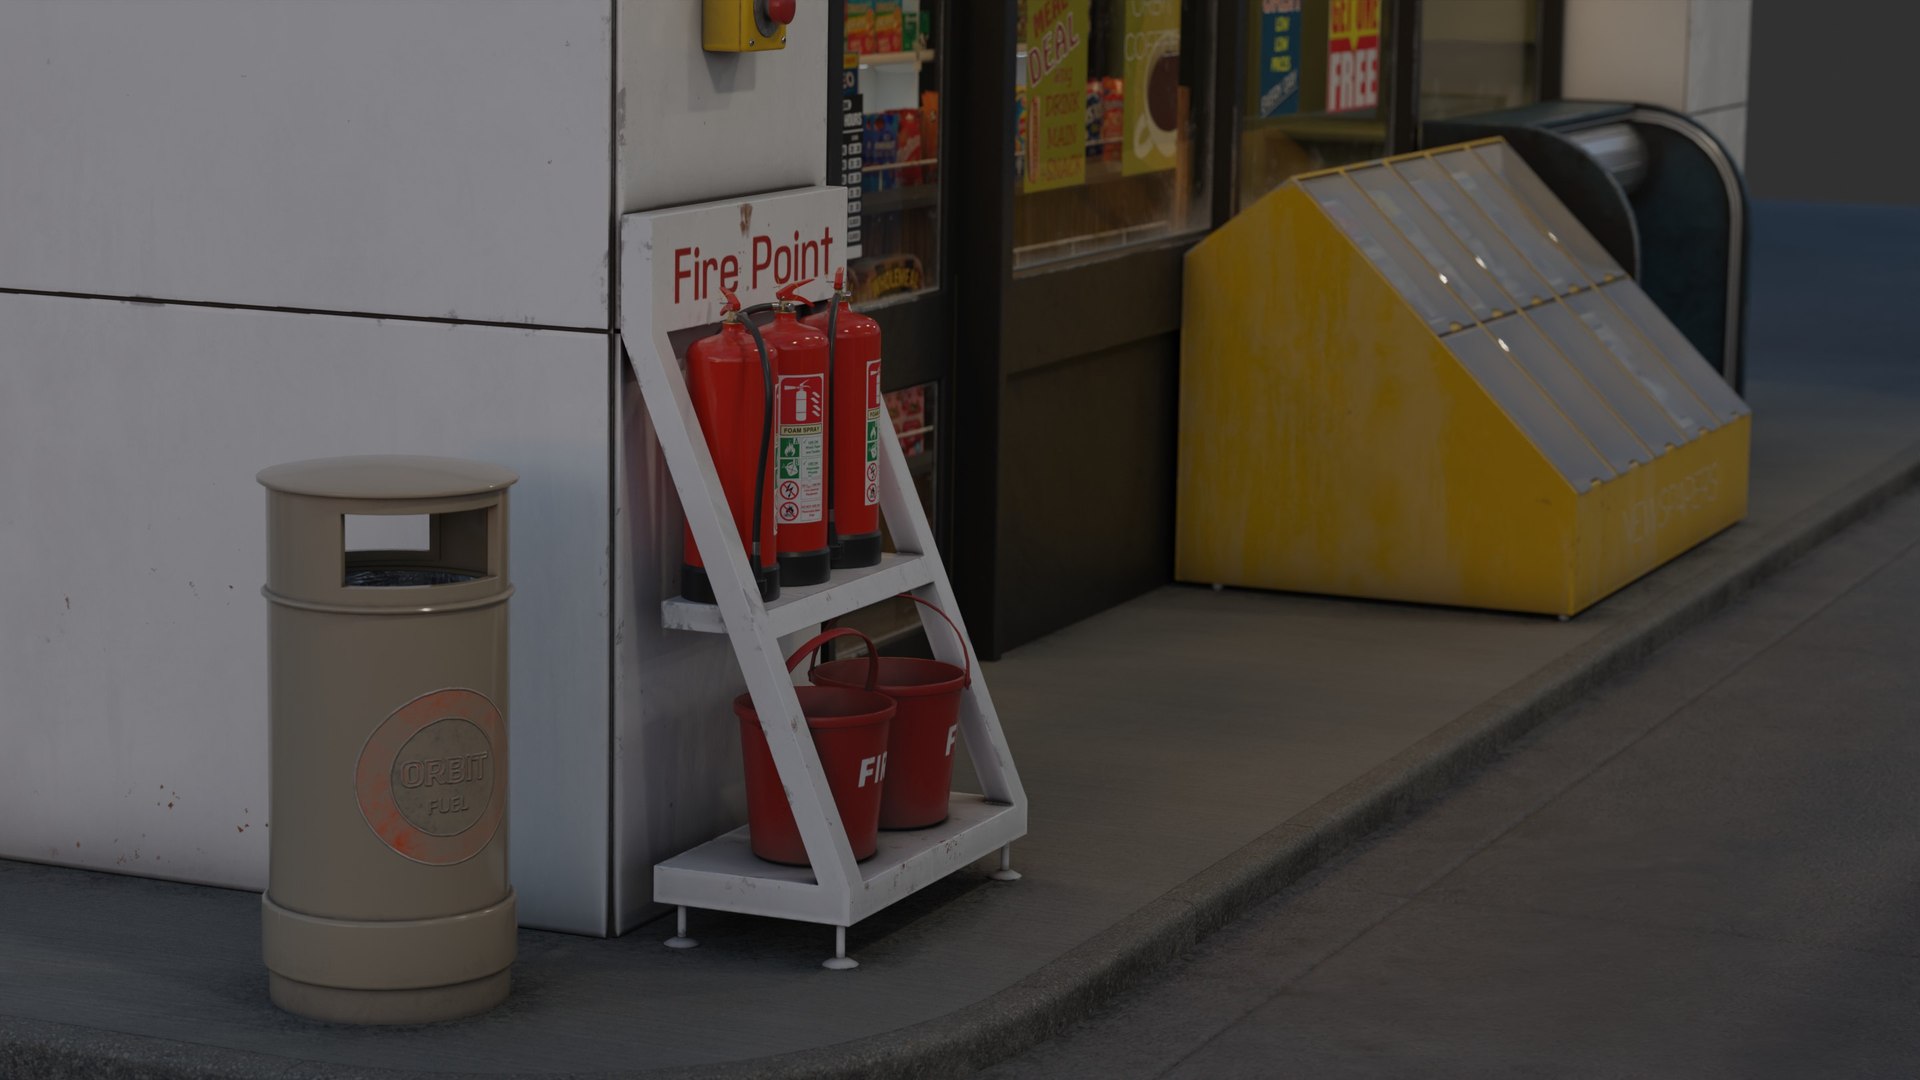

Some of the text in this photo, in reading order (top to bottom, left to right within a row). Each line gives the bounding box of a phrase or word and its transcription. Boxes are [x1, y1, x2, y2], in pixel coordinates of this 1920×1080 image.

[1033, 0, 1068, 38] MEAL
[1028, 11, 1080, 88] DEAL
[1330, 49, 1378, 113] FREE
[674, 227, 833, 304] Fire Point
[401, 752, 489, 789] ORBIT
[427, 795, 470, 816] FUEL
